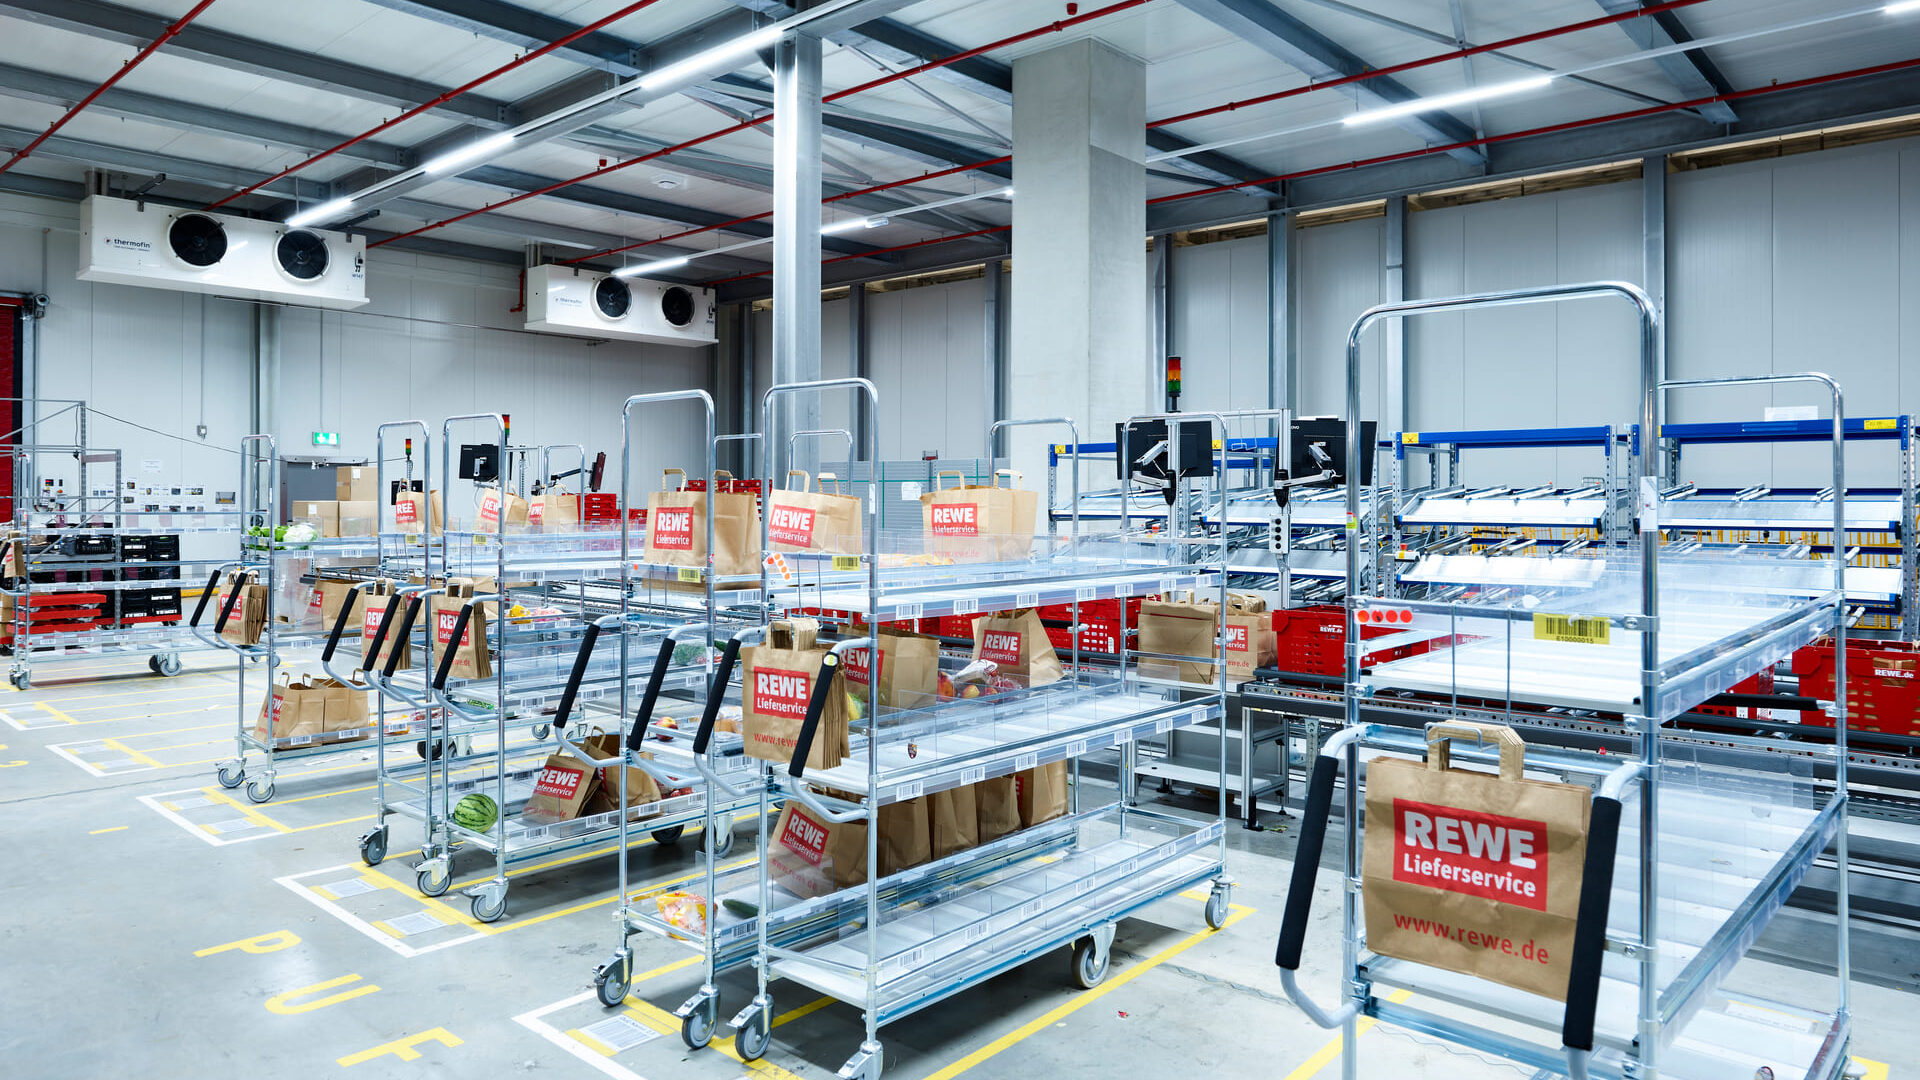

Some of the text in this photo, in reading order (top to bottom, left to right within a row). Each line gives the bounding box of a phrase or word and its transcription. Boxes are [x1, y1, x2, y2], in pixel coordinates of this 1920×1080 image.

[114, 238, 151, 248] thermofin
[657, 512, 689, 532] REWE
[771, 509, 811, 531] REWE
[935, 507, 974, 523] REWE
[984, 633, 1018, 651] REWE
[840, 649, 870, 668] REW
[1874, 669, 1915, 678] REWE.de
[757, 673, 807, 699] REWE
[757, 697, 807, 714] Lieferservice
[537, 784, 573, 797] eferservice
[788, 813, 825, 851] REWE
[1404, 810, 1537, 869] REWE
[783, 832, 819, 862] Lieferservice
[1404, 852, 1537, 898] Lieferservice
[1393, 913, 1550, 965] www.rewe.de
